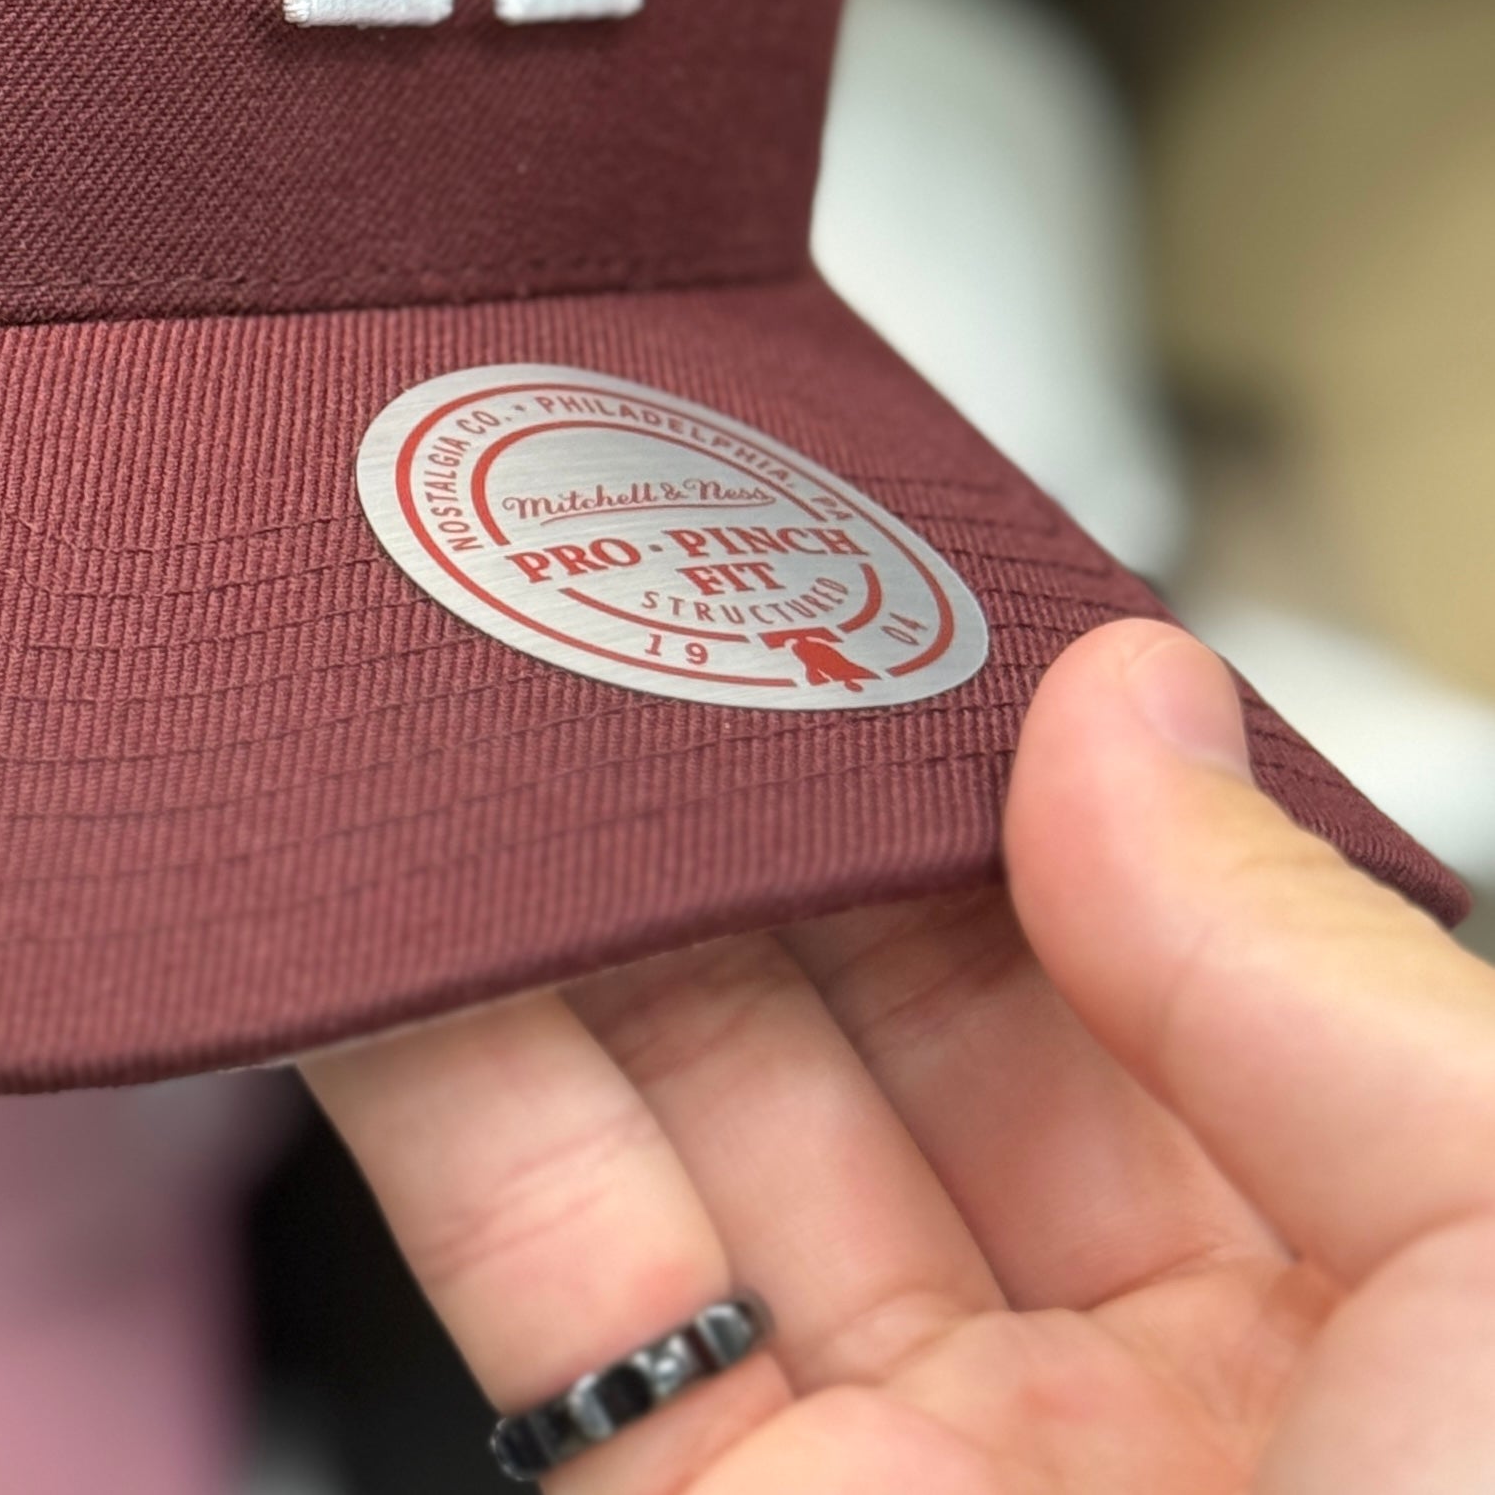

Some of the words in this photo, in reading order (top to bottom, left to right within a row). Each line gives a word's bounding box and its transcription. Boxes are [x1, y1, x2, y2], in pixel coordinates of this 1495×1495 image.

[423, 435, 485, 552] NOSTALGIA
[456, 409, 512, 435] CO.
[502, 483, 657, 520] Mitchell
[659, 482, 687, 501] &
[682, 478, 772, 503] Ness
[660, 526, 870, 558] PINCH
[640, 576, 849, 626] STRUCTURED
[674, 561, 786, 596] FIT
[644, 633, 709, 666] 19
[880, 611, 929, 646] 04
